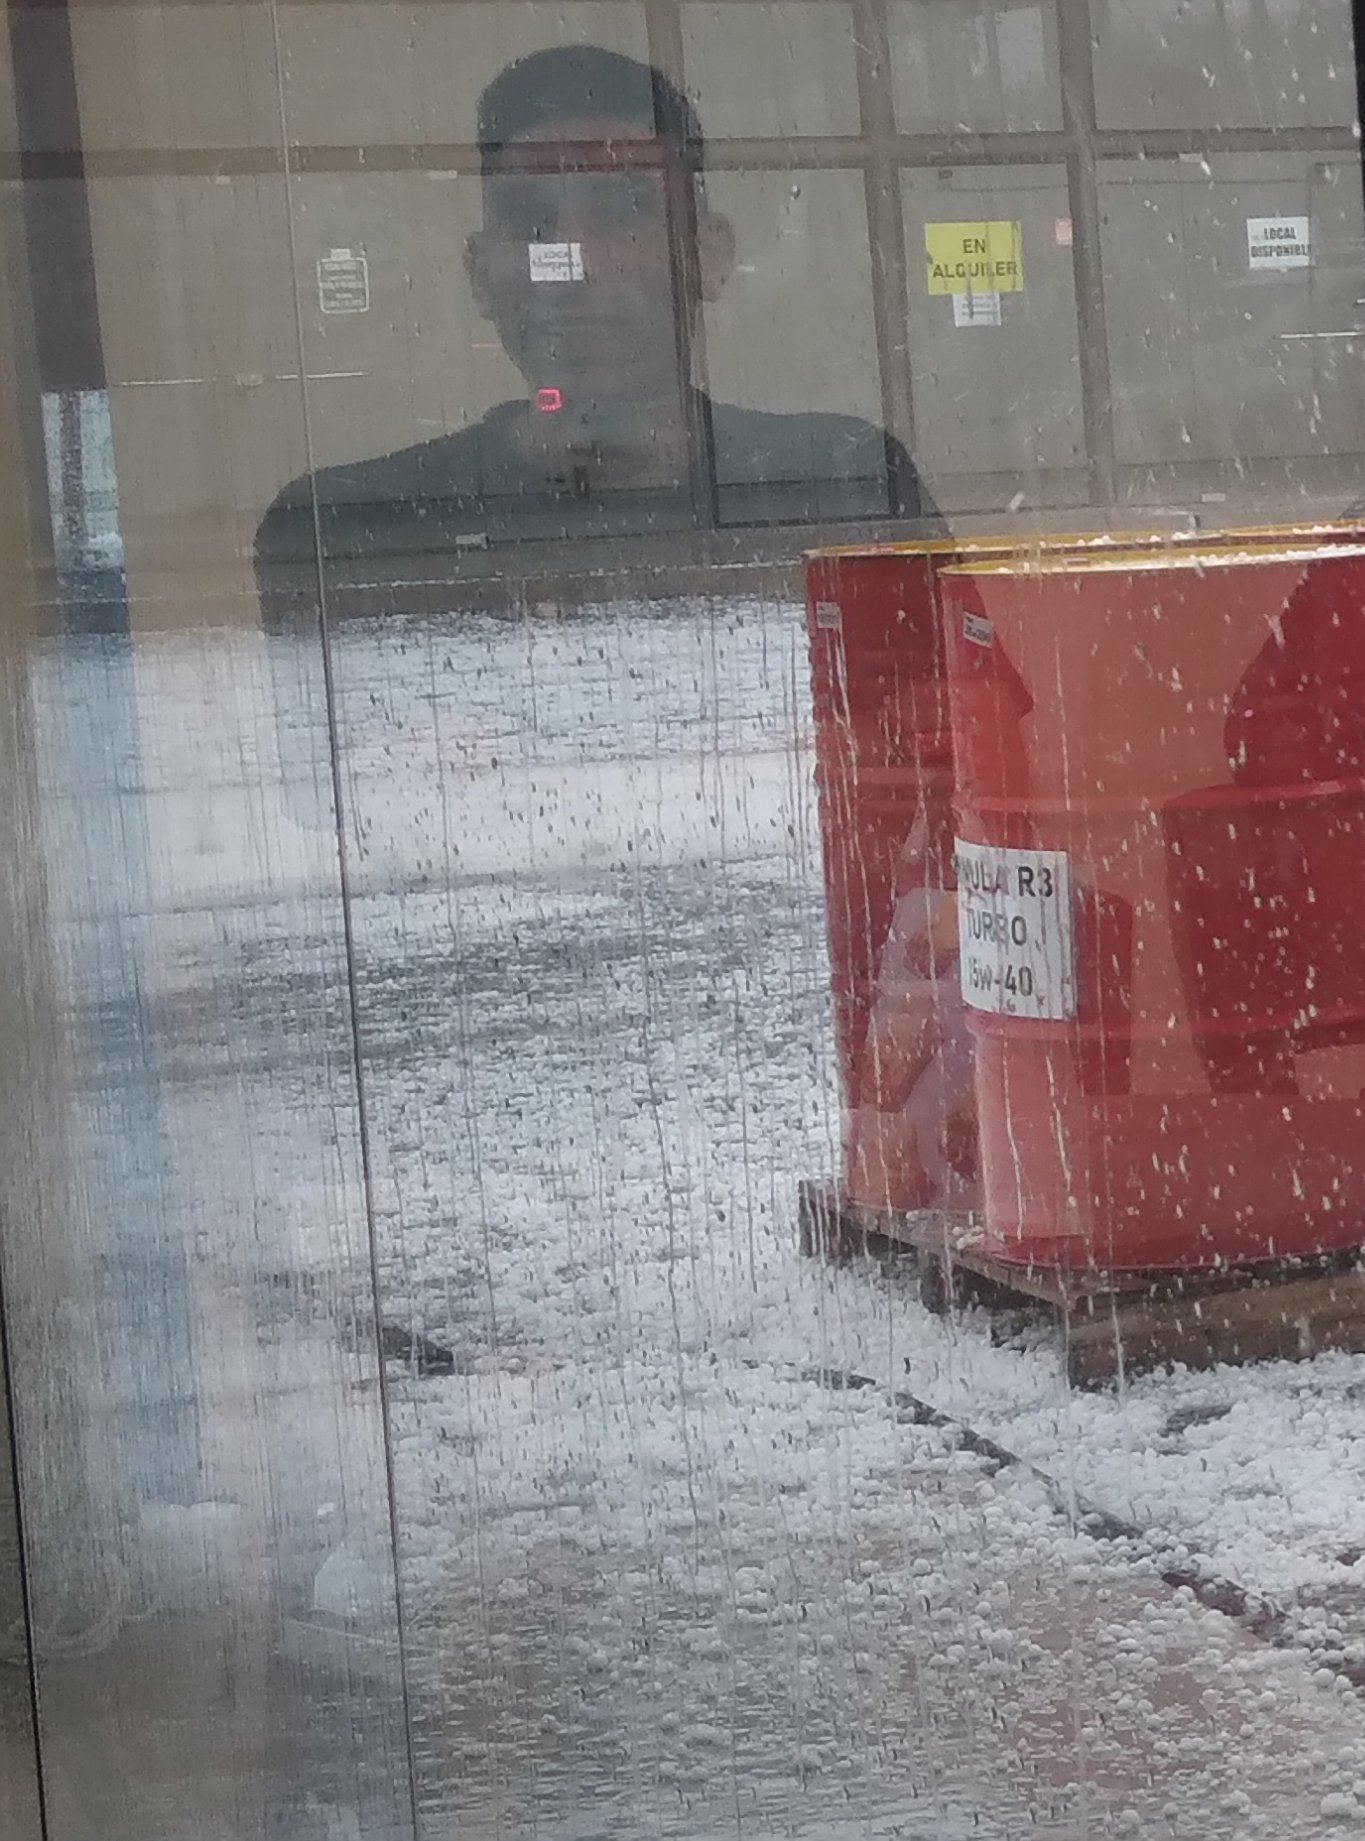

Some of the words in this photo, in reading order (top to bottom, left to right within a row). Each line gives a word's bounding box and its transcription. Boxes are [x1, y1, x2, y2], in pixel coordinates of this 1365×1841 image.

[1263, 227, 1297, 240] LOCAL
[962, 238, 986, 254] EN
[1017, 865, 1053, 898] R3
[966, 907, 1028, 947] TURBO
